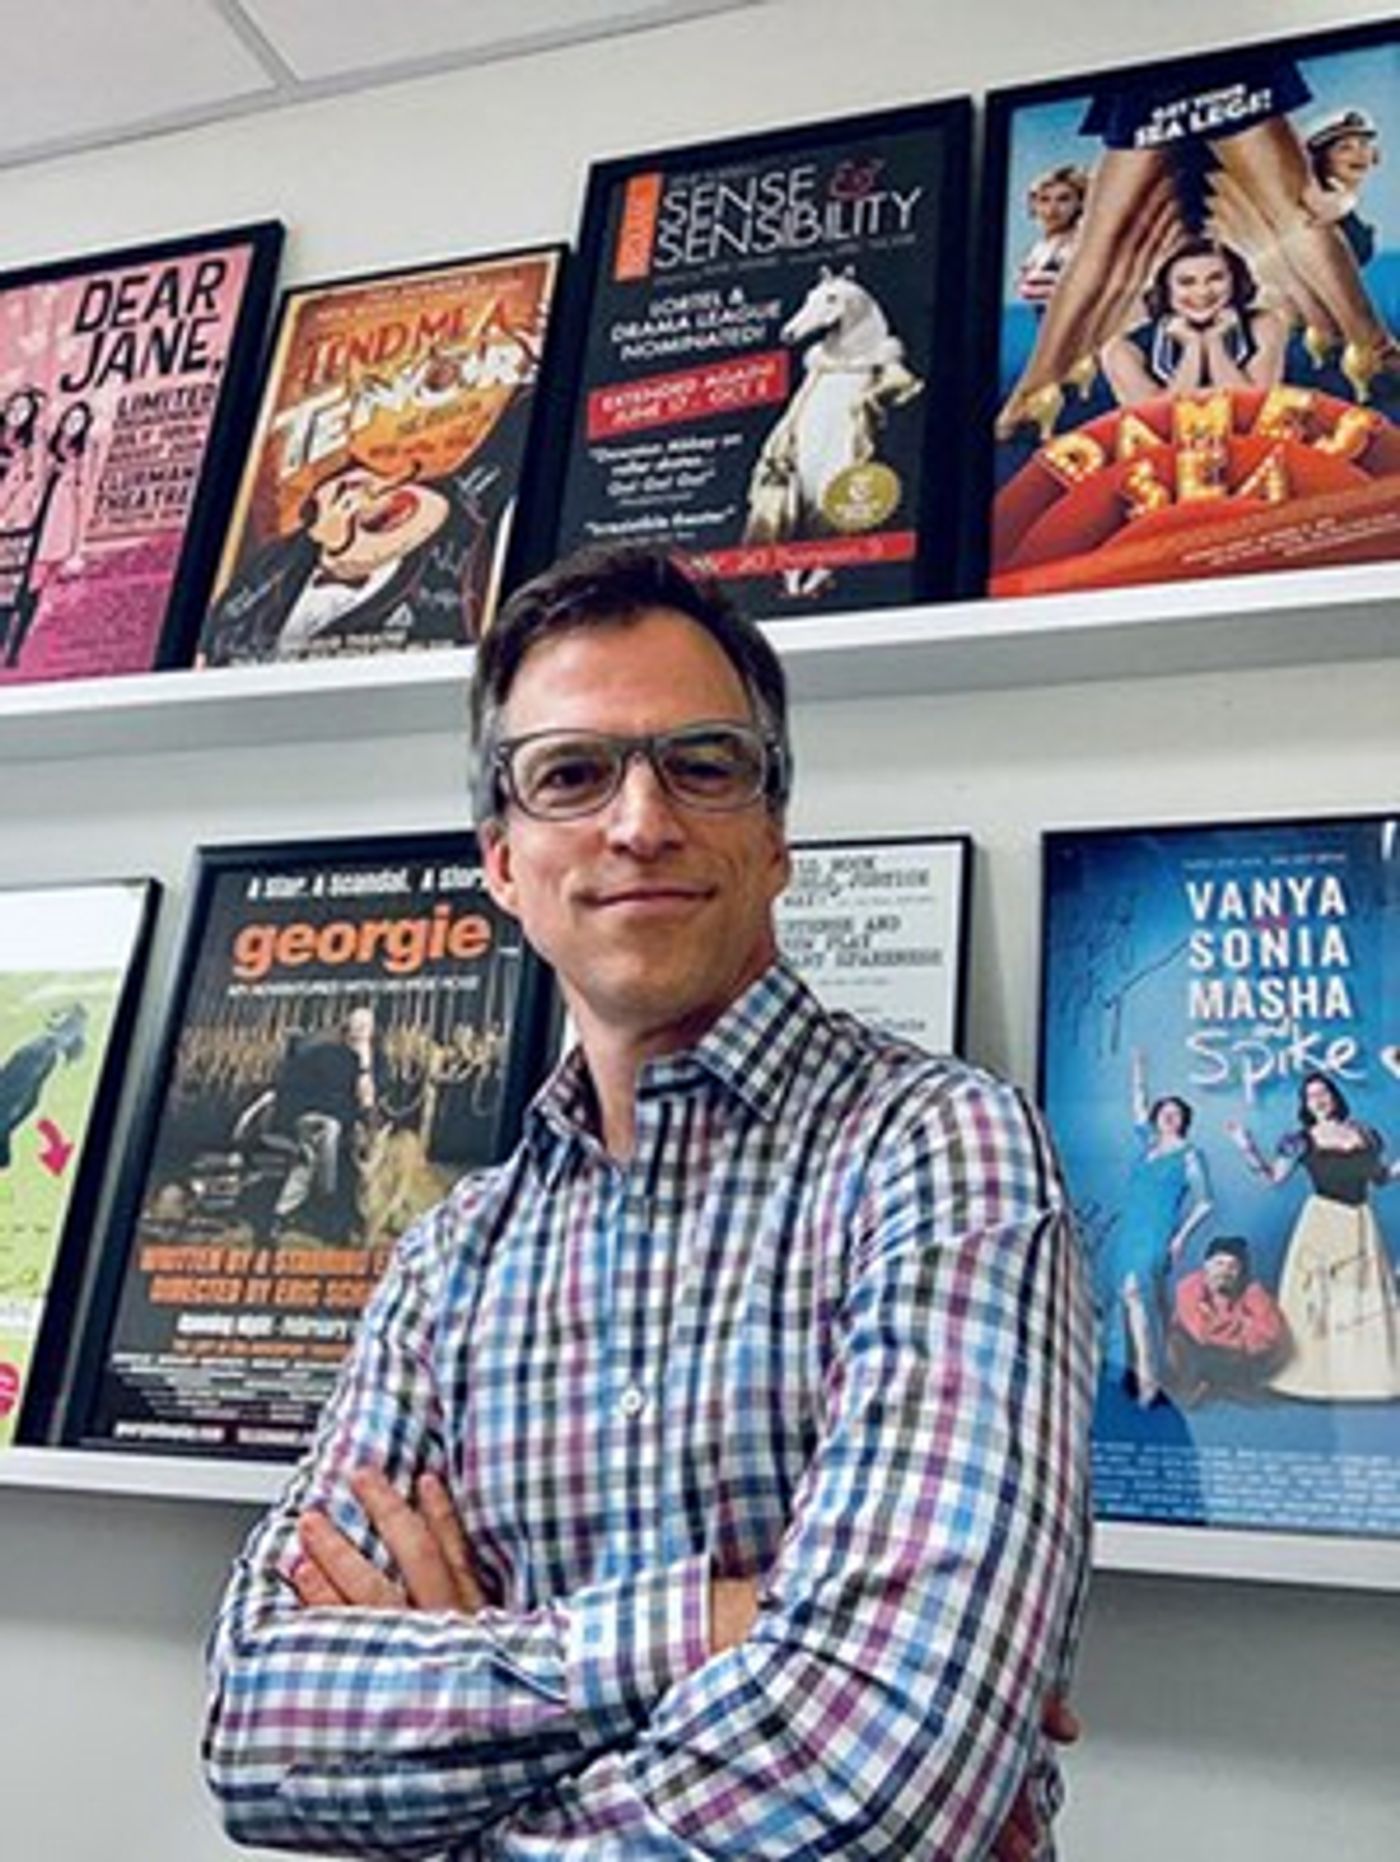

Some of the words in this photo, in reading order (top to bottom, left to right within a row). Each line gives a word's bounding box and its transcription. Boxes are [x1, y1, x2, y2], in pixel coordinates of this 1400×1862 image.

[1134, 120, 1186, 148] SEA
[1189, 88, 1272, 132] LEGS!
[653, 186, 923, 269] SENSIBILITY
[663, 164, 817, 236] SENSE
[72, 260, 227, 334] DEAR
[611, 316, 689, 343] DRAMA
[695, 300, 781, 328] LEAGUE
[60, 316, 224, 393] JANE,
[117, 382, 216, 418] LIMITED
[273, 338, 541, 478] TENOR
[1186, 875, 1347, 921] VANYA
[231, 901, 493, 981] georgie
[1188, 925, 1350, 971] SONIA
[1188, 975, 1353, 1020] MASHA
[1185, 1022, 1369, 1106] Spike
